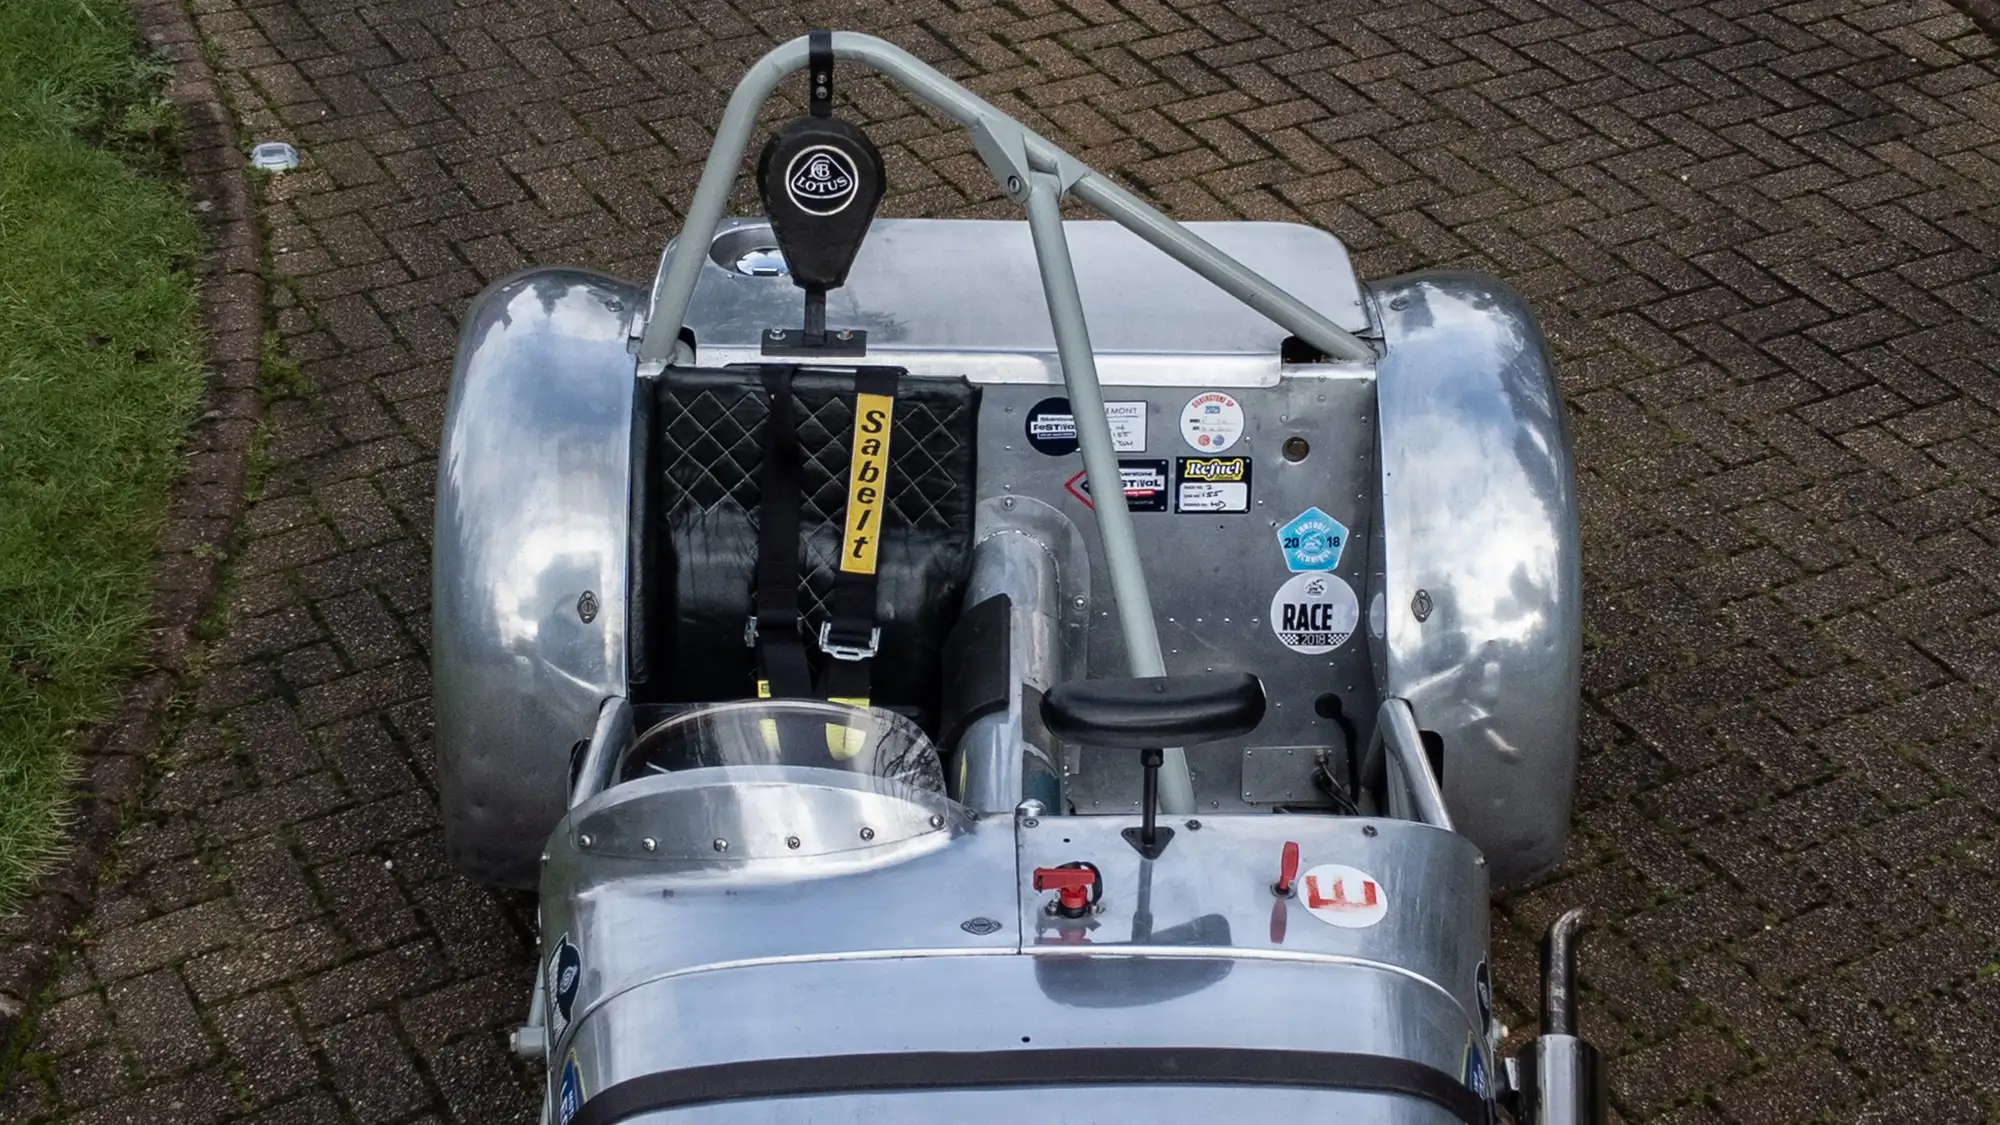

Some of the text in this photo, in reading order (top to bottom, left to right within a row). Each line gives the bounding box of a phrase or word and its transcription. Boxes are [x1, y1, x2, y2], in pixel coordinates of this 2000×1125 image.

[796, 176, 848, 193] LOTUS
[1189, 461, 1241, 478] Refuel
[852, 410, 887, 559] Sabelt
[1284, 537, 1300, 549] 20
[1326, 536, 1341, 548] 18
[1282, 603, 1333, 631] RACE
[1300, 633, 1327, 646] 2018
